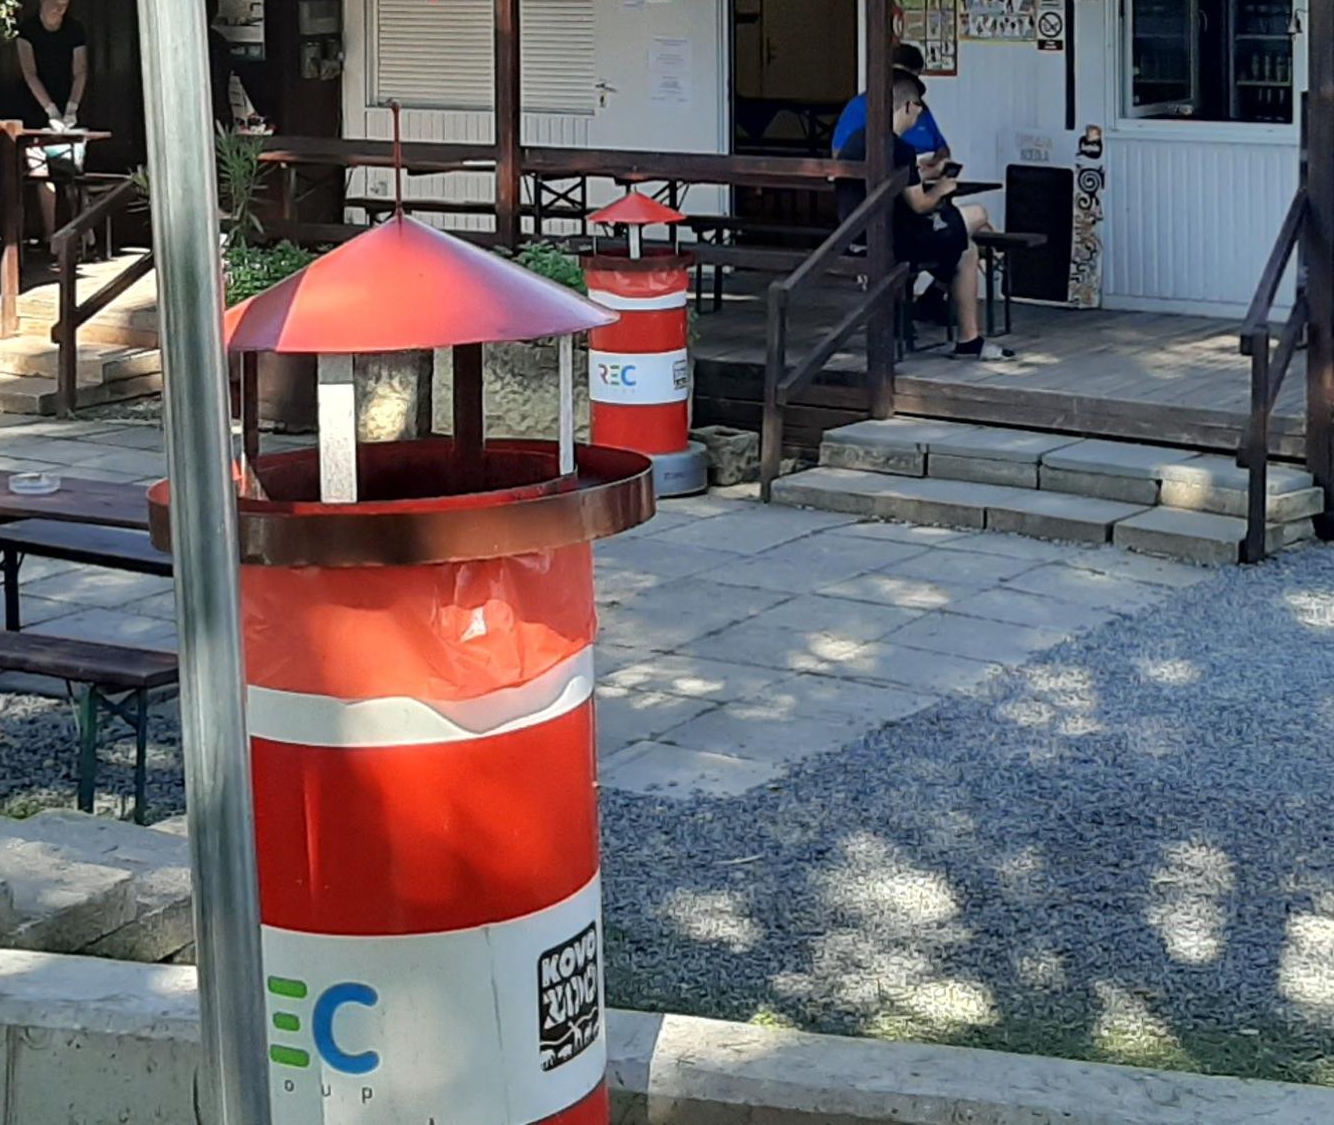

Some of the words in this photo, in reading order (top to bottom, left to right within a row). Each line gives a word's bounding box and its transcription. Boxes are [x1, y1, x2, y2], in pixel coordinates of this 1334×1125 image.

[598, 363, 637, 386] REC
[541, 928, 597, 986] KOVO
[267, 974, 380, 1076] EC
